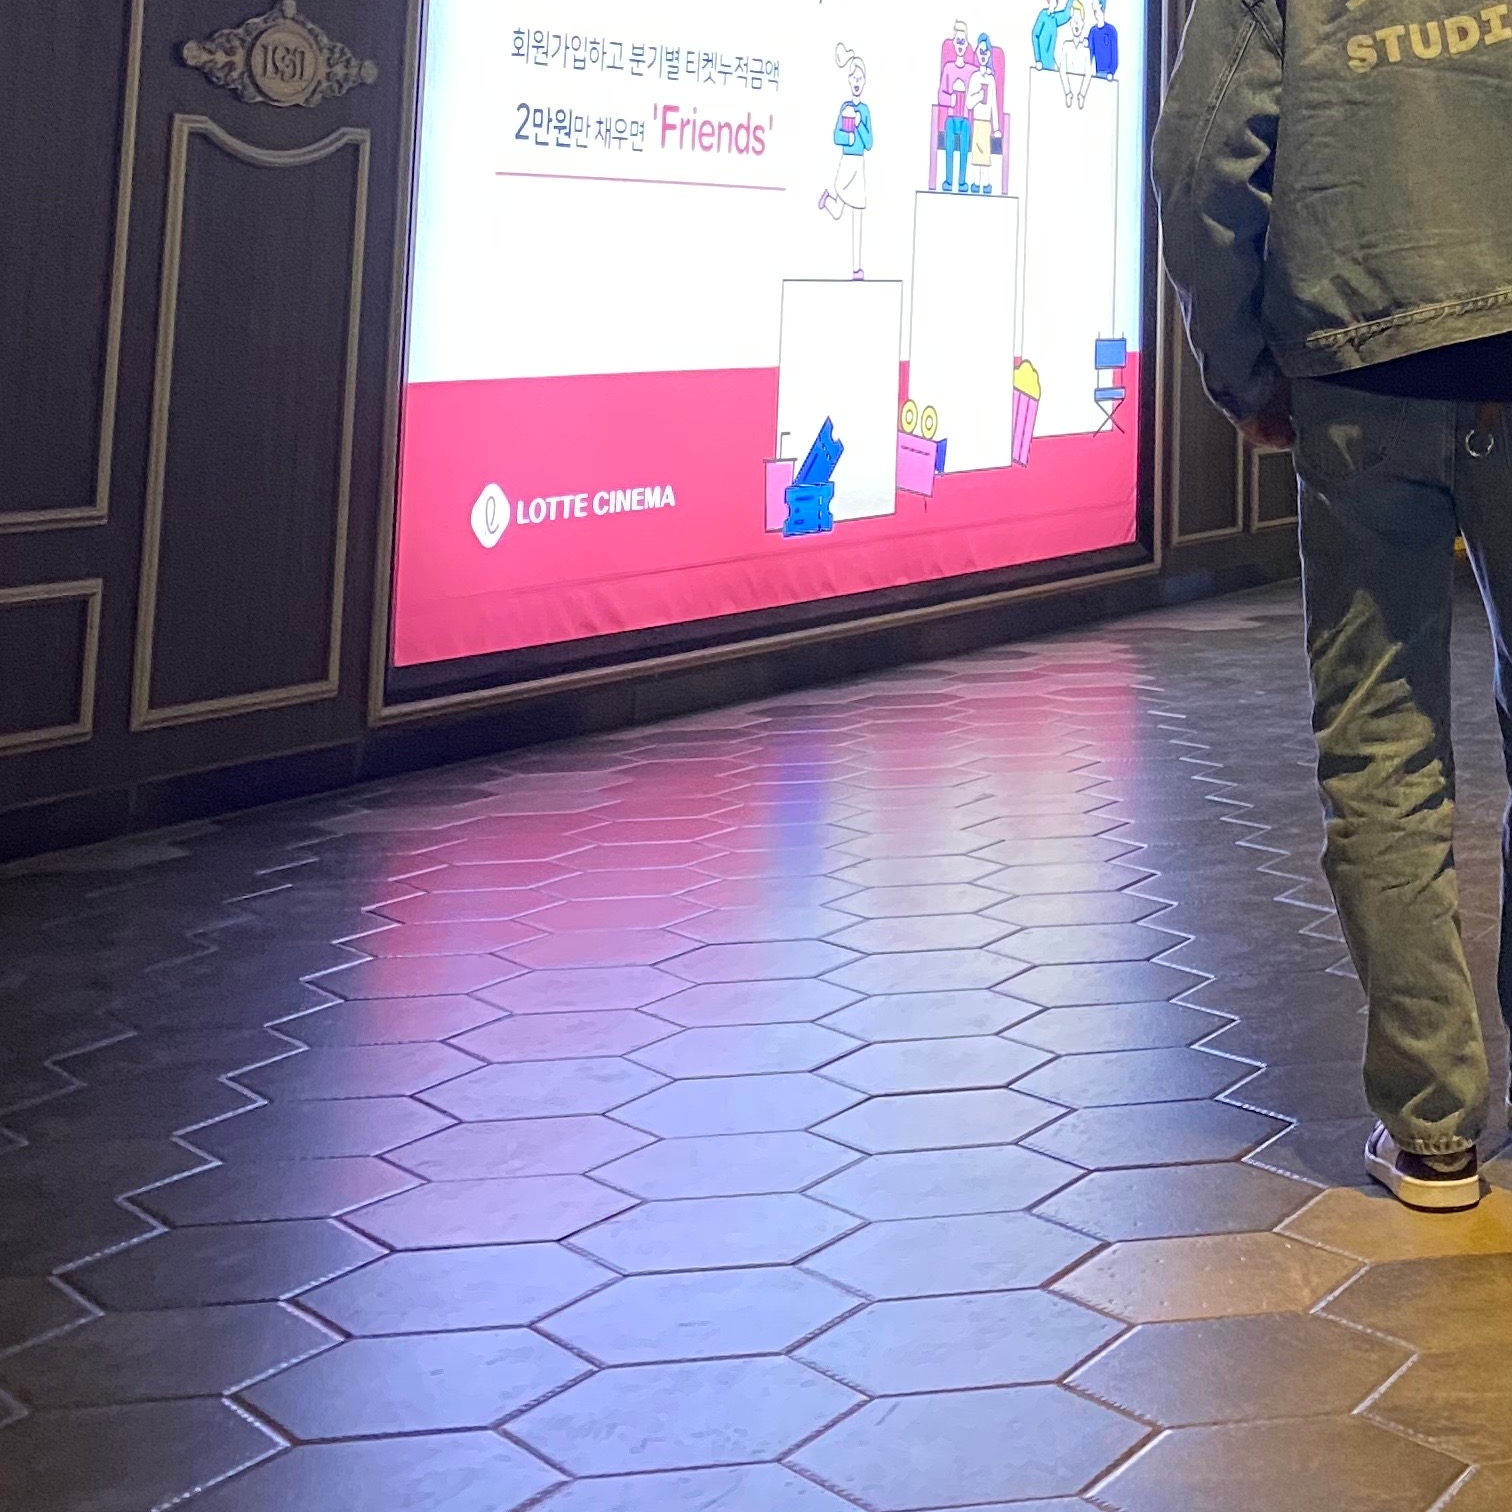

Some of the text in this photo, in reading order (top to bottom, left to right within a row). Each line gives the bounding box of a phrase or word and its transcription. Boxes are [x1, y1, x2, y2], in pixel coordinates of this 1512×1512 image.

[511, 27, 624, 72] 회원가입하고
[628, 42, 681, 81] 분기별
[595, 116, 645, 152] 채우면
[653, 103, 773, 156] 'Friends'
[516, 484, 676, 525] LOTTE CINEMA
